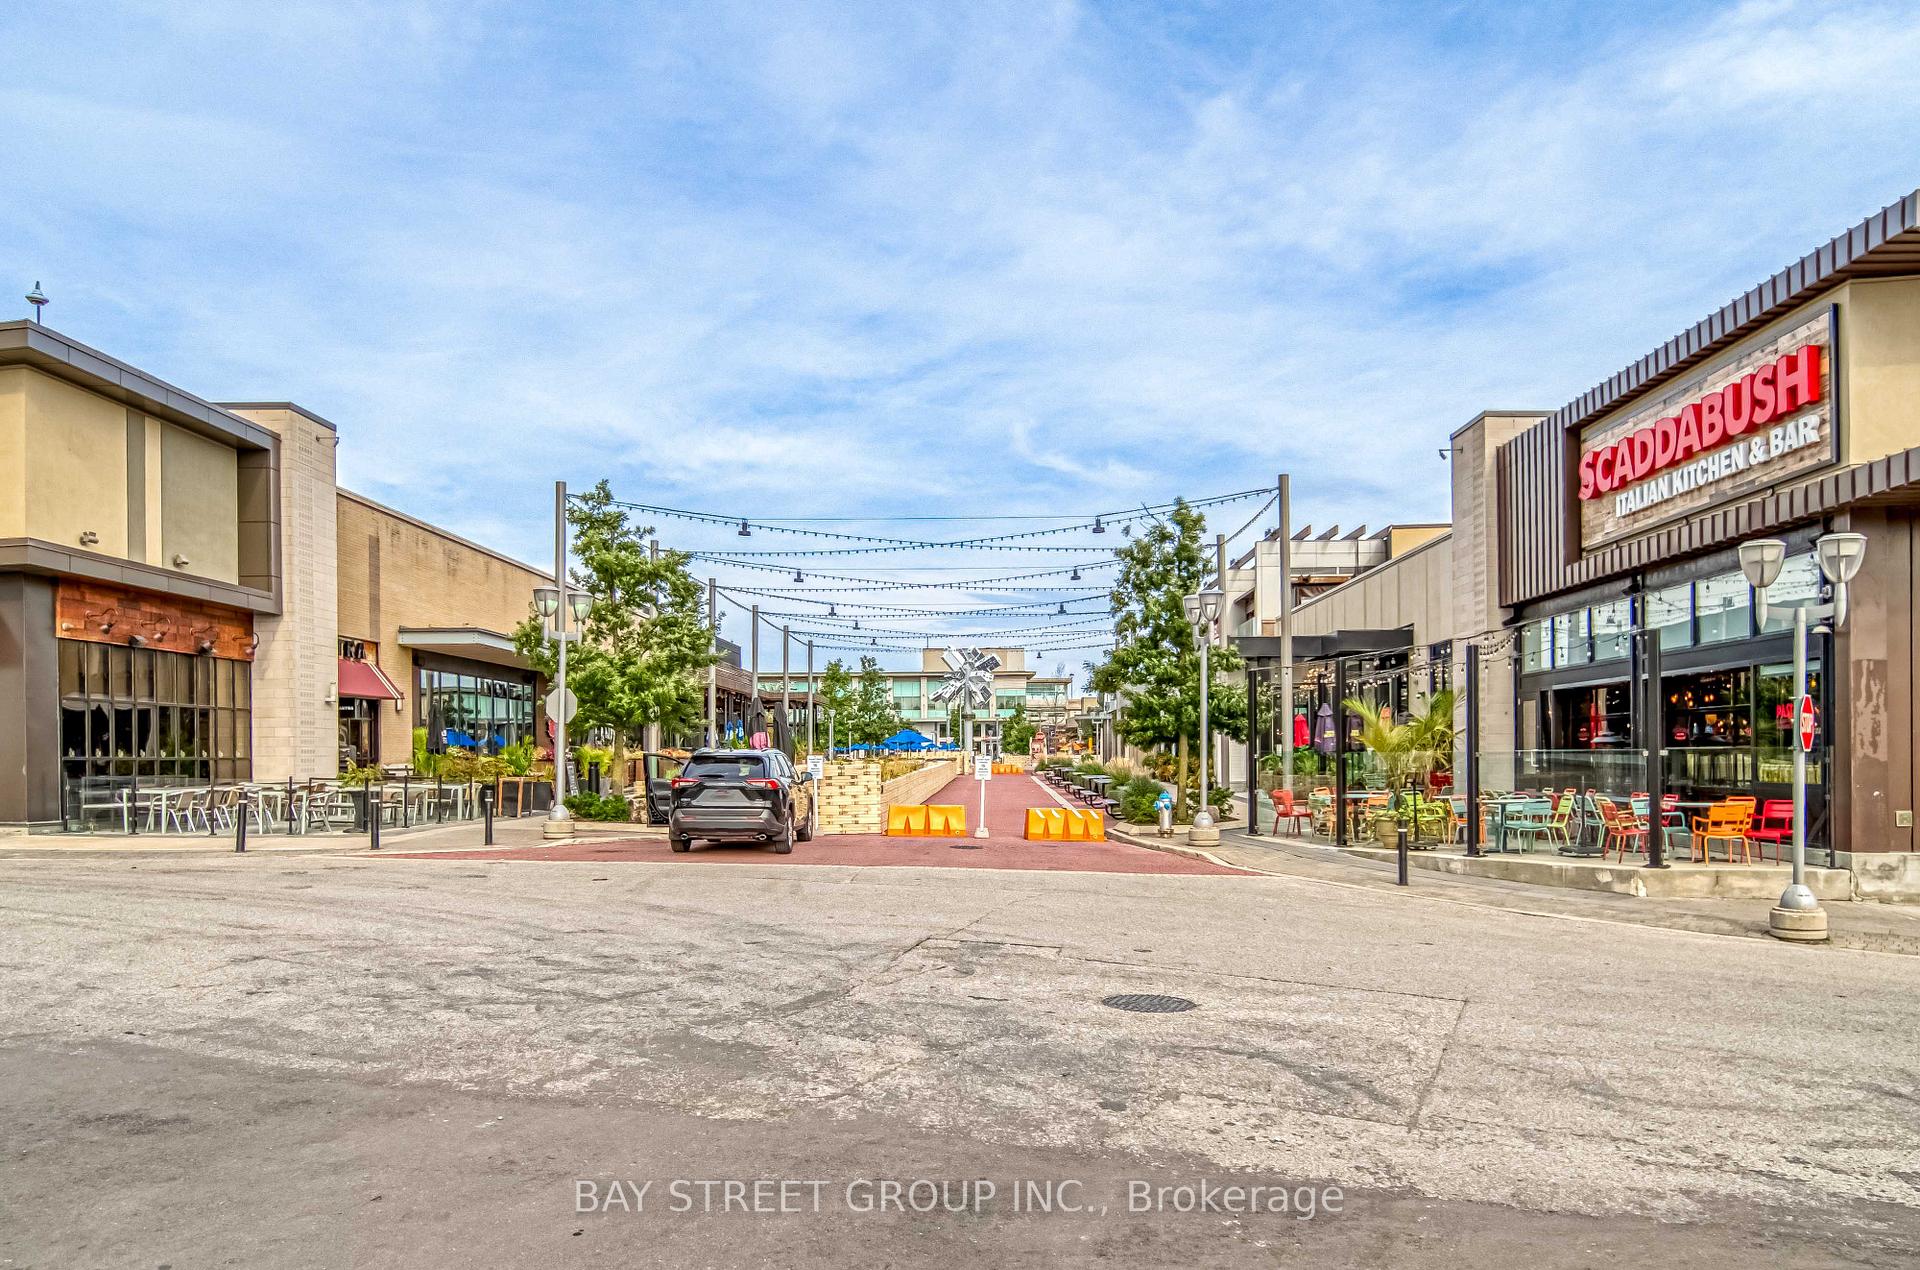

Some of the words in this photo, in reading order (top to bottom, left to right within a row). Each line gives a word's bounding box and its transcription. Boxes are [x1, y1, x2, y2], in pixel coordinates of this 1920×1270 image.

[1578, 344, 1821, 500] SCADDABUSH
[1616, 474, 1673, 518] ITALIAN
[1672, 441, 1750, 492] KITCHEN
[1749, 436, 1770, 466] &
[1769, 414, 1821, 459] BAR
